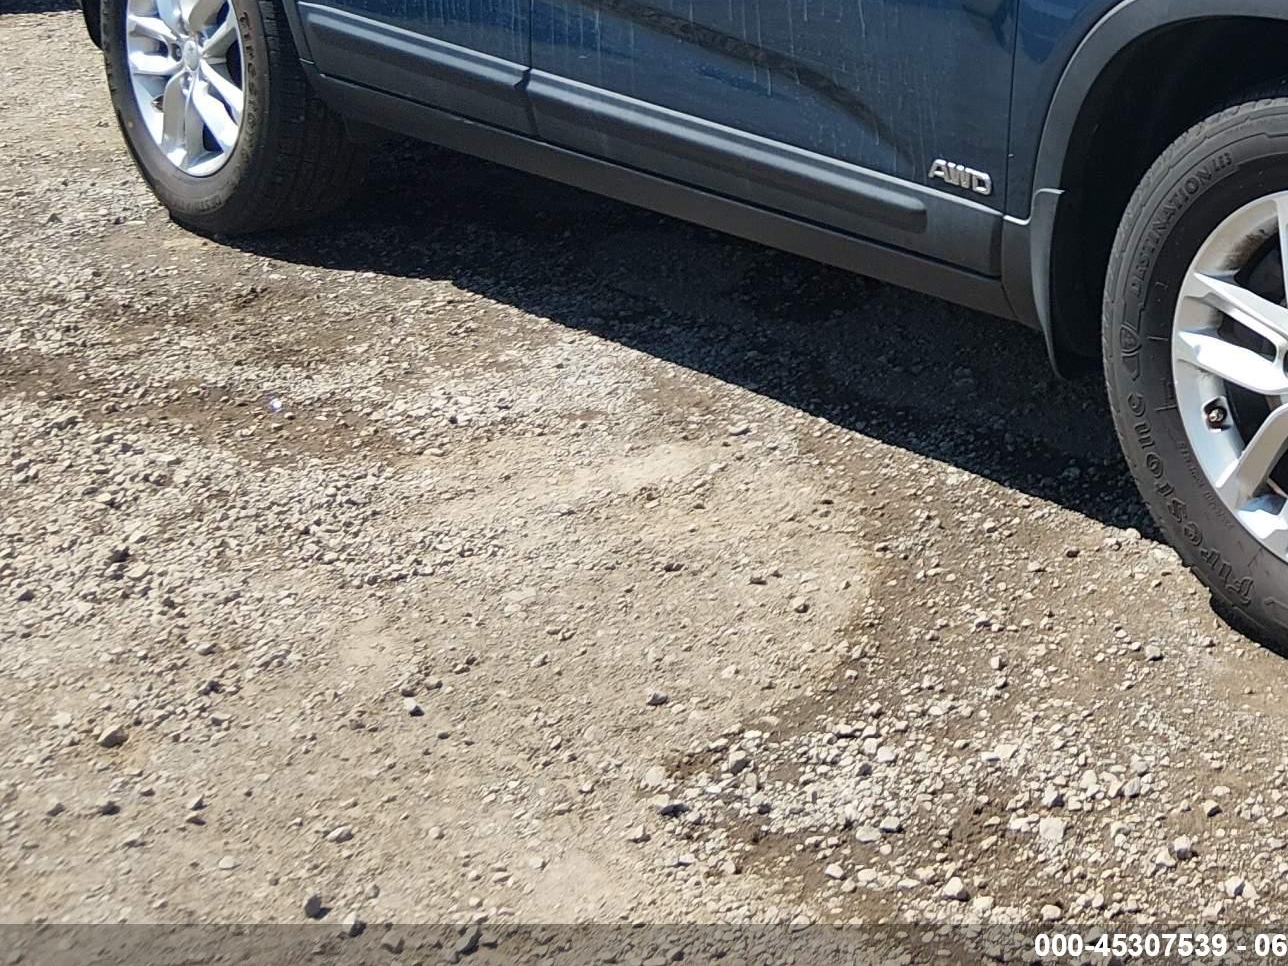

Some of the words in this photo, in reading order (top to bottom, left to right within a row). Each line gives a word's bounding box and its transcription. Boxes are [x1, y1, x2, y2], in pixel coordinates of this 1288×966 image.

[928, 158, 992, 195] AWD
[1131, 168, 1213, 298] DESTINATION
[1127, 392, 1254, 606] Firestone
